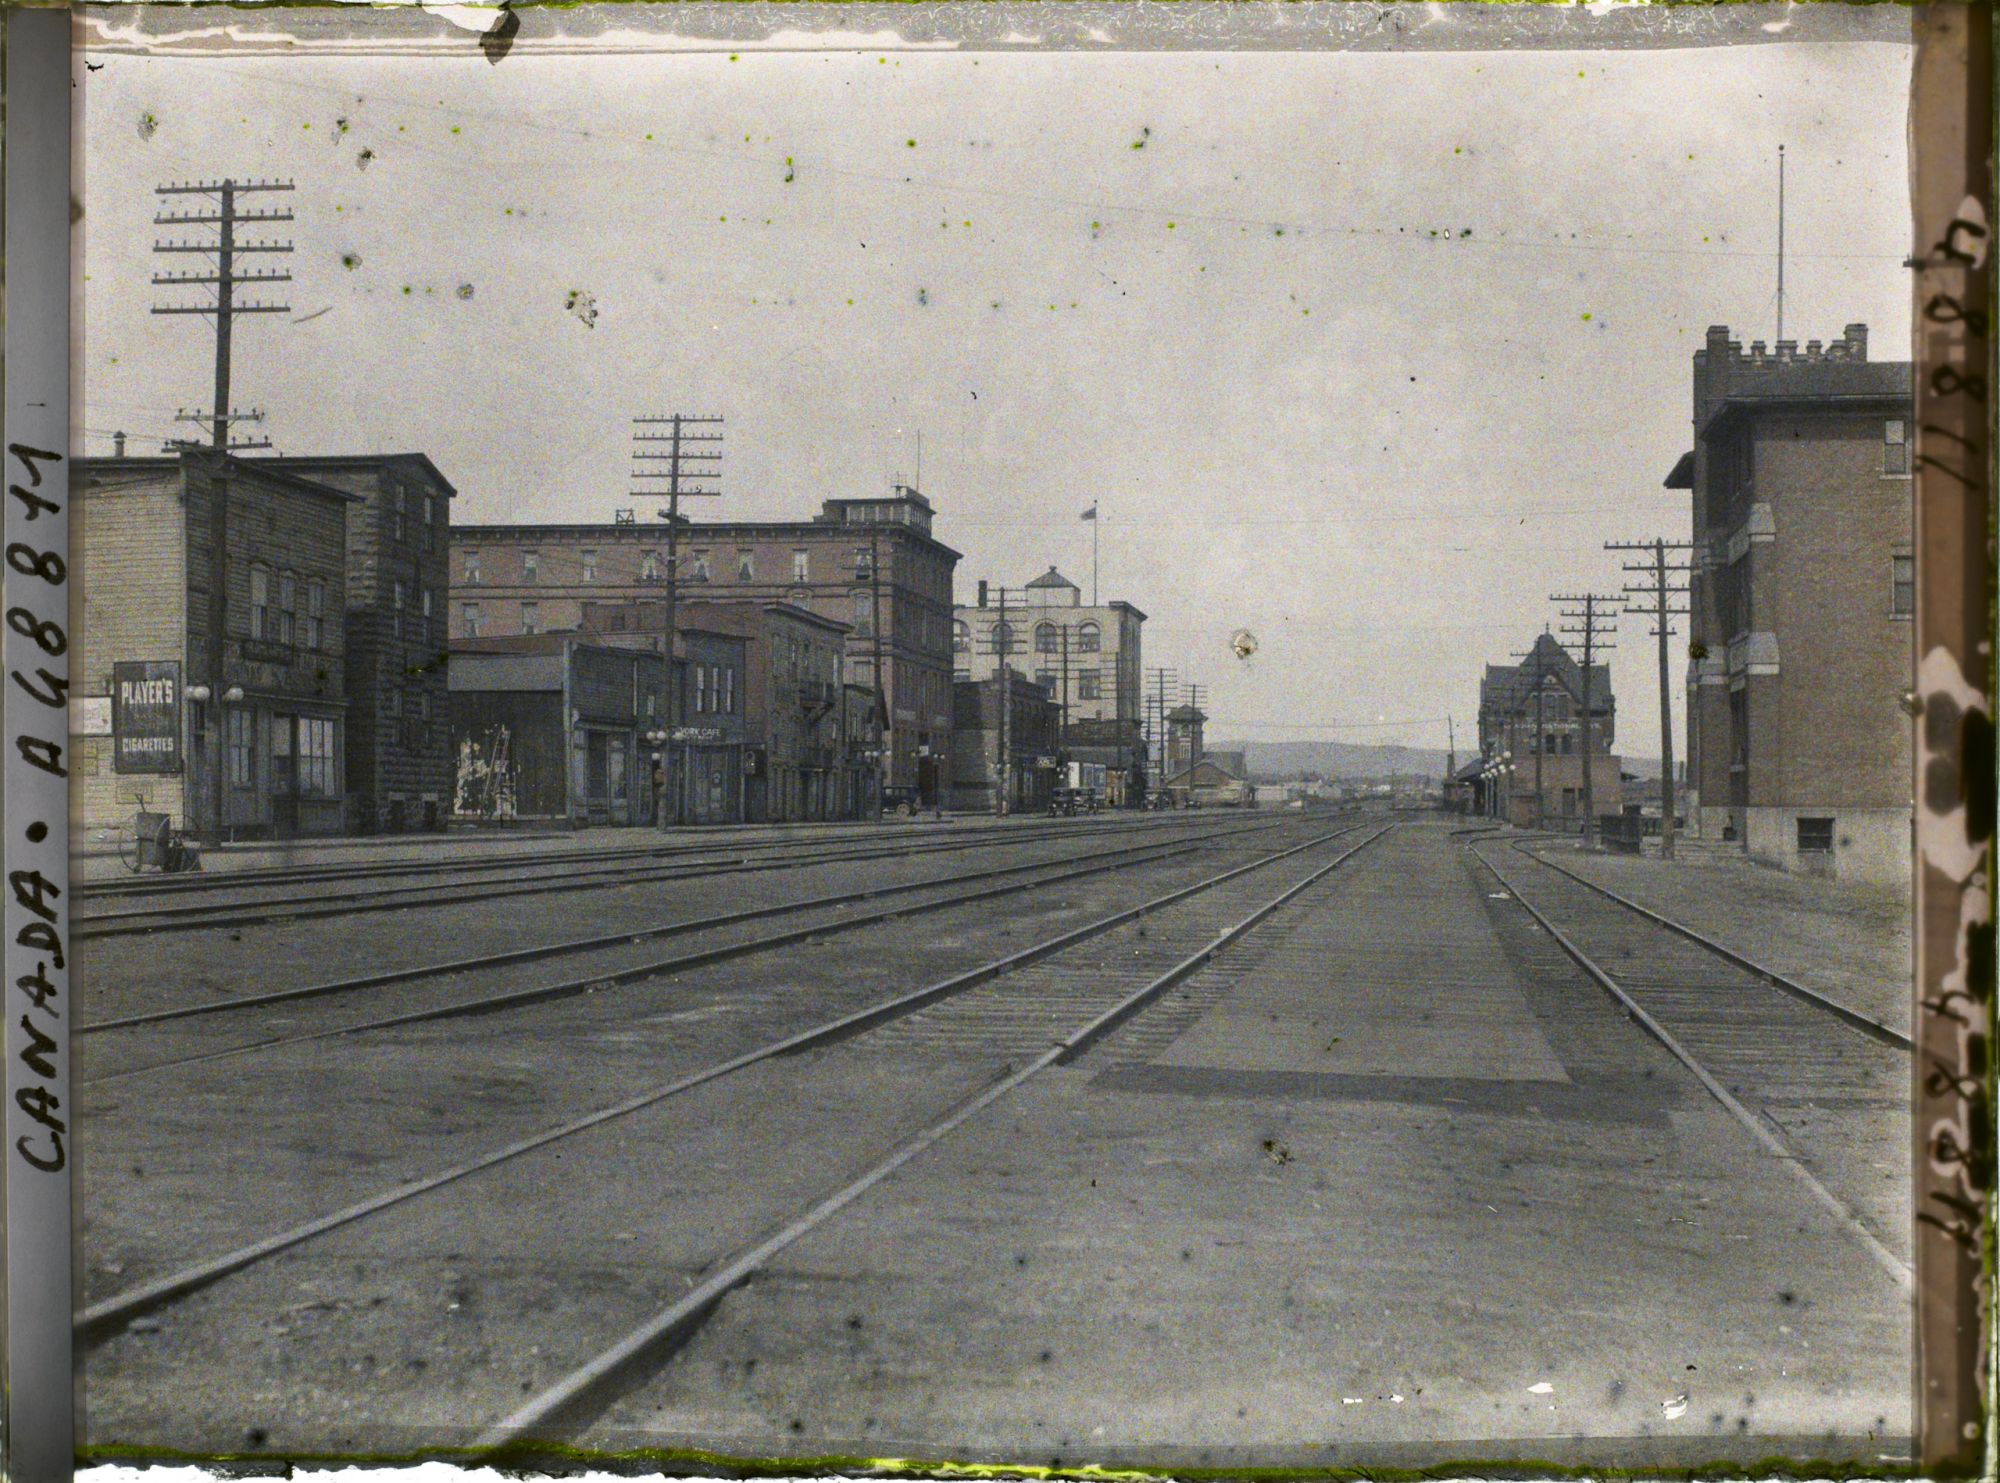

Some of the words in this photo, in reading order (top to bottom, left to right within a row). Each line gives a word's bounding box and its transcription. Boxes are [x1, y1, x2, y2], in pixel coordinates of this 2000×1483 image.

[121, 678, 173, 704] PLAYER'S
[701, 727, 721, 737] CAFE
[122, 737, 174, 752] CIGARETTES
[8, 870, 65, 1173] CANADA
